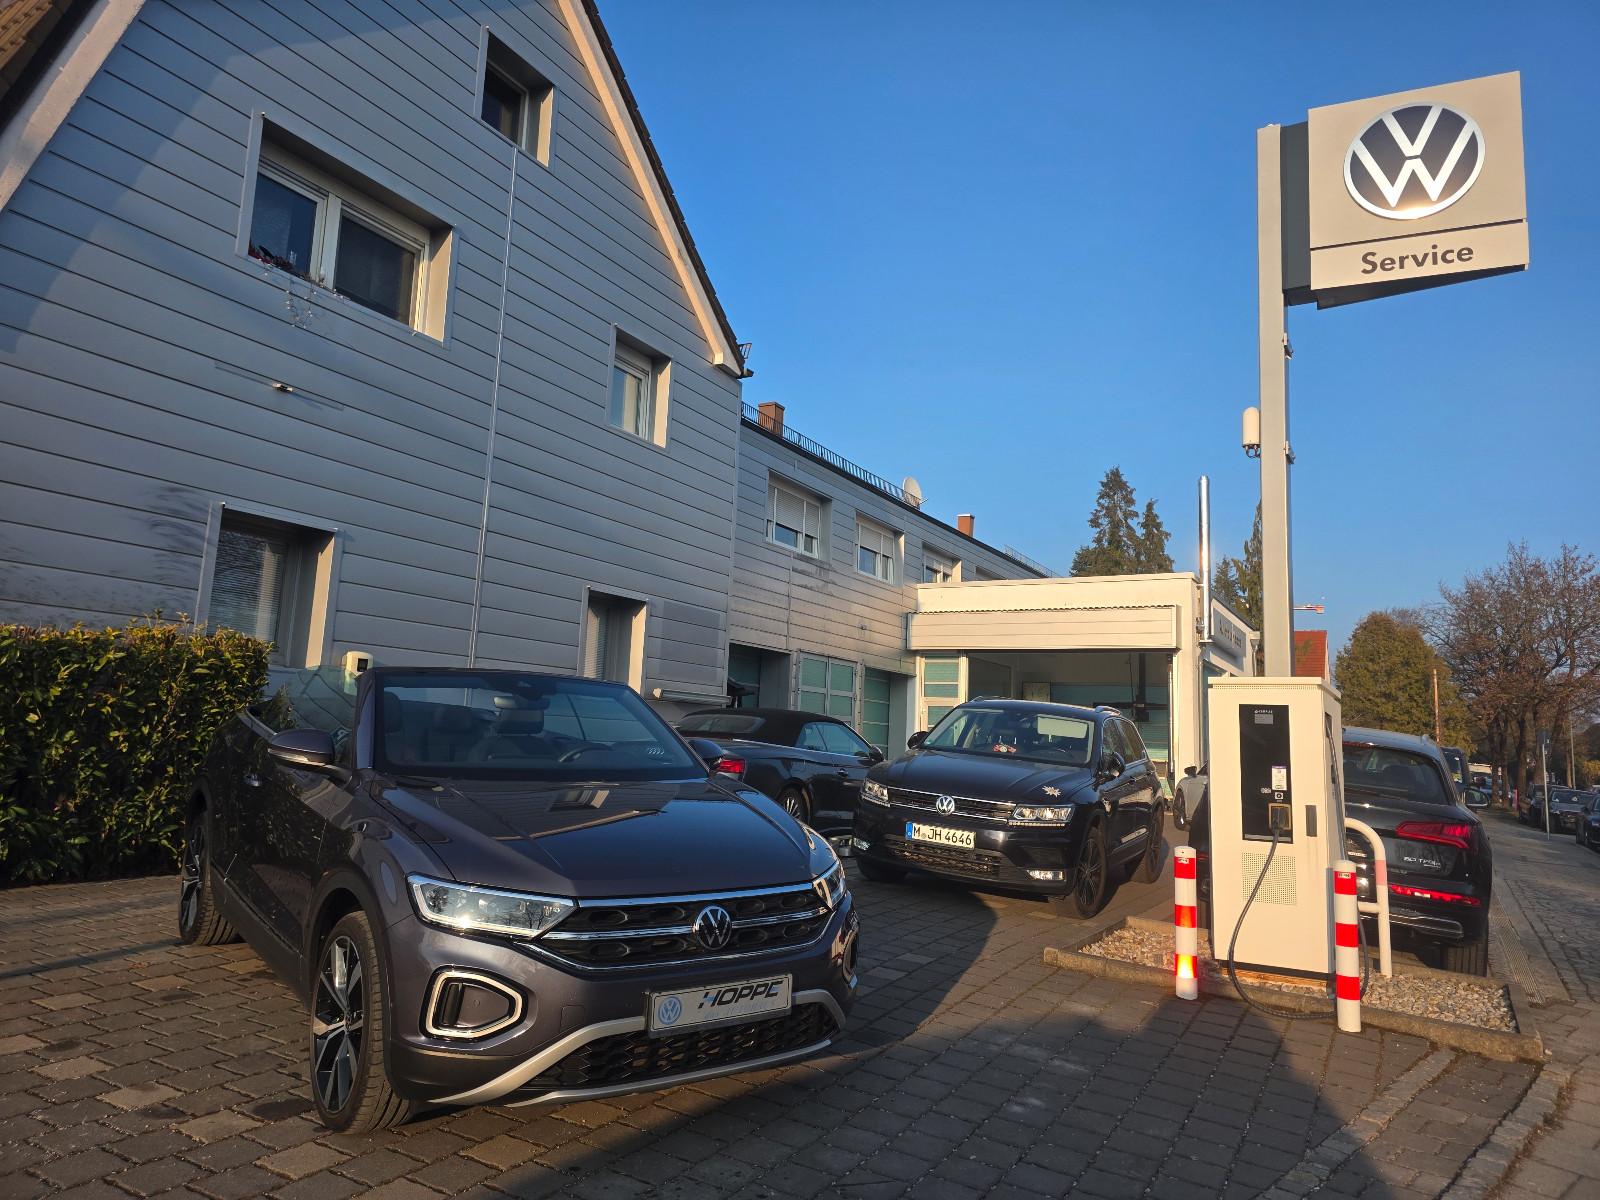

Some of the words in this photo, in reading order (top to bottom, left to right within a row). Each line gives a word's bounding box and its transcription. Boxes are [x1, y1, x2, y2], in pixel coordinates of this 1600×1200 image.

[1361, 244, 1474, 274] Service
[913, 826, 921, 838] M
[927, 828, 942, 840] JH
[944, 832, 972, 845] 4646
[697, 980, 783, 1009] HOPPE
